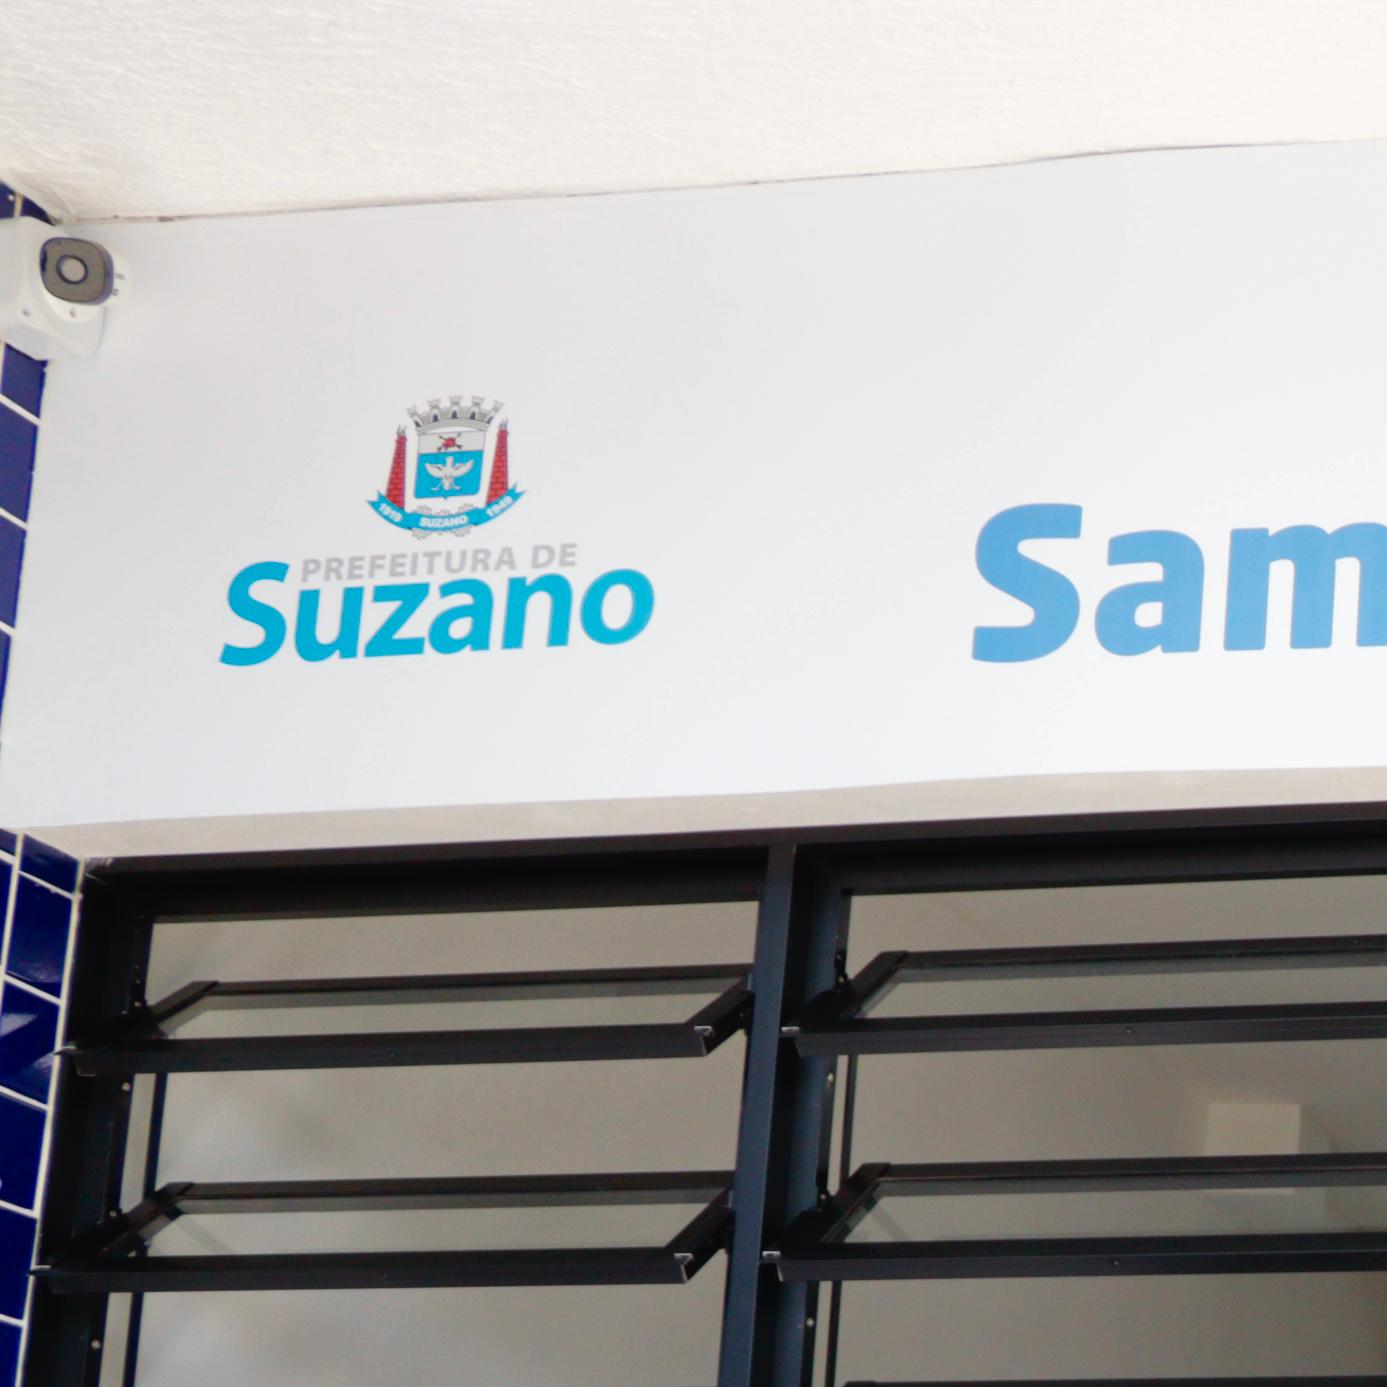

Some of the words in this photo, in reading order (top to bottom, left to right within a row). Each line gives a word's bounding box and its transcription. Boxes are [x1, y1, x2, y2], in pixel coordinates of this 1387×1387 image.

[379, 502, 403, 522] 1919
[419, 514, 469, 527] SUZANO
[486, 495, 513, 516] 1949
[301, 546, 517, 583] PREFEITURA
[530, 543, 578, 570] DE
[219, 560, 656, 668] Suzano
